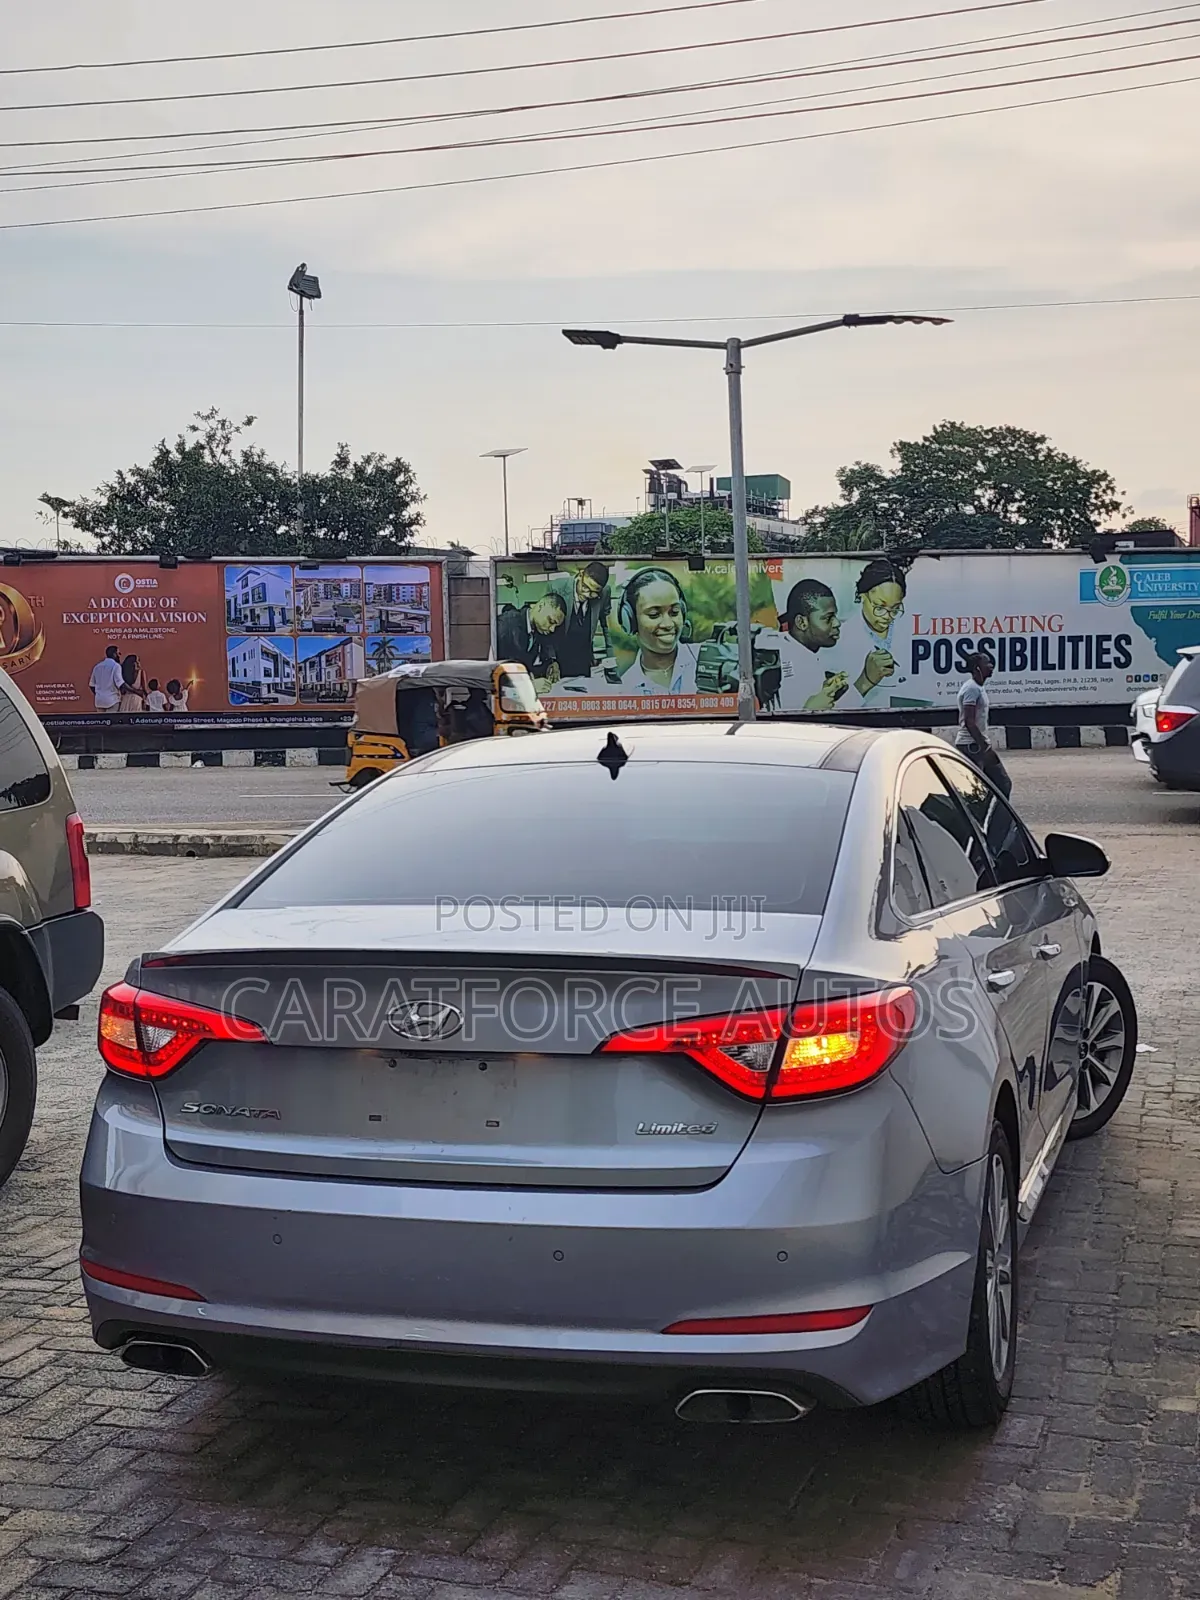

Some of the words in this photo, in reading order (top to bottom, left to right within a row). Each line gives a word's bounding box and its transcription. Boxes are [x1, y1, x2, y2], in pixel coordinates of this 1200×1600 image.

[1133, 572, 1171, 583] CALEB
[1137, 582, 1199, 593] UNIVERSITY
[28, 596, 45, 607] TH
[87, 598, 98, 609] A
[100, 597, 157, 609] DECADE
[159, 596, 179, 608] OF
[62, 612, 159, 624] EXCEPTIONAL
[160, 611, 207, 623] VISION
[1170, 610, 1186, 619] Your
[911, 633, 1132, 675] POSSIBILITIES
[180, 1102, 281, 1120] SONATA
[635, 1120, 718, 1135] Limited
